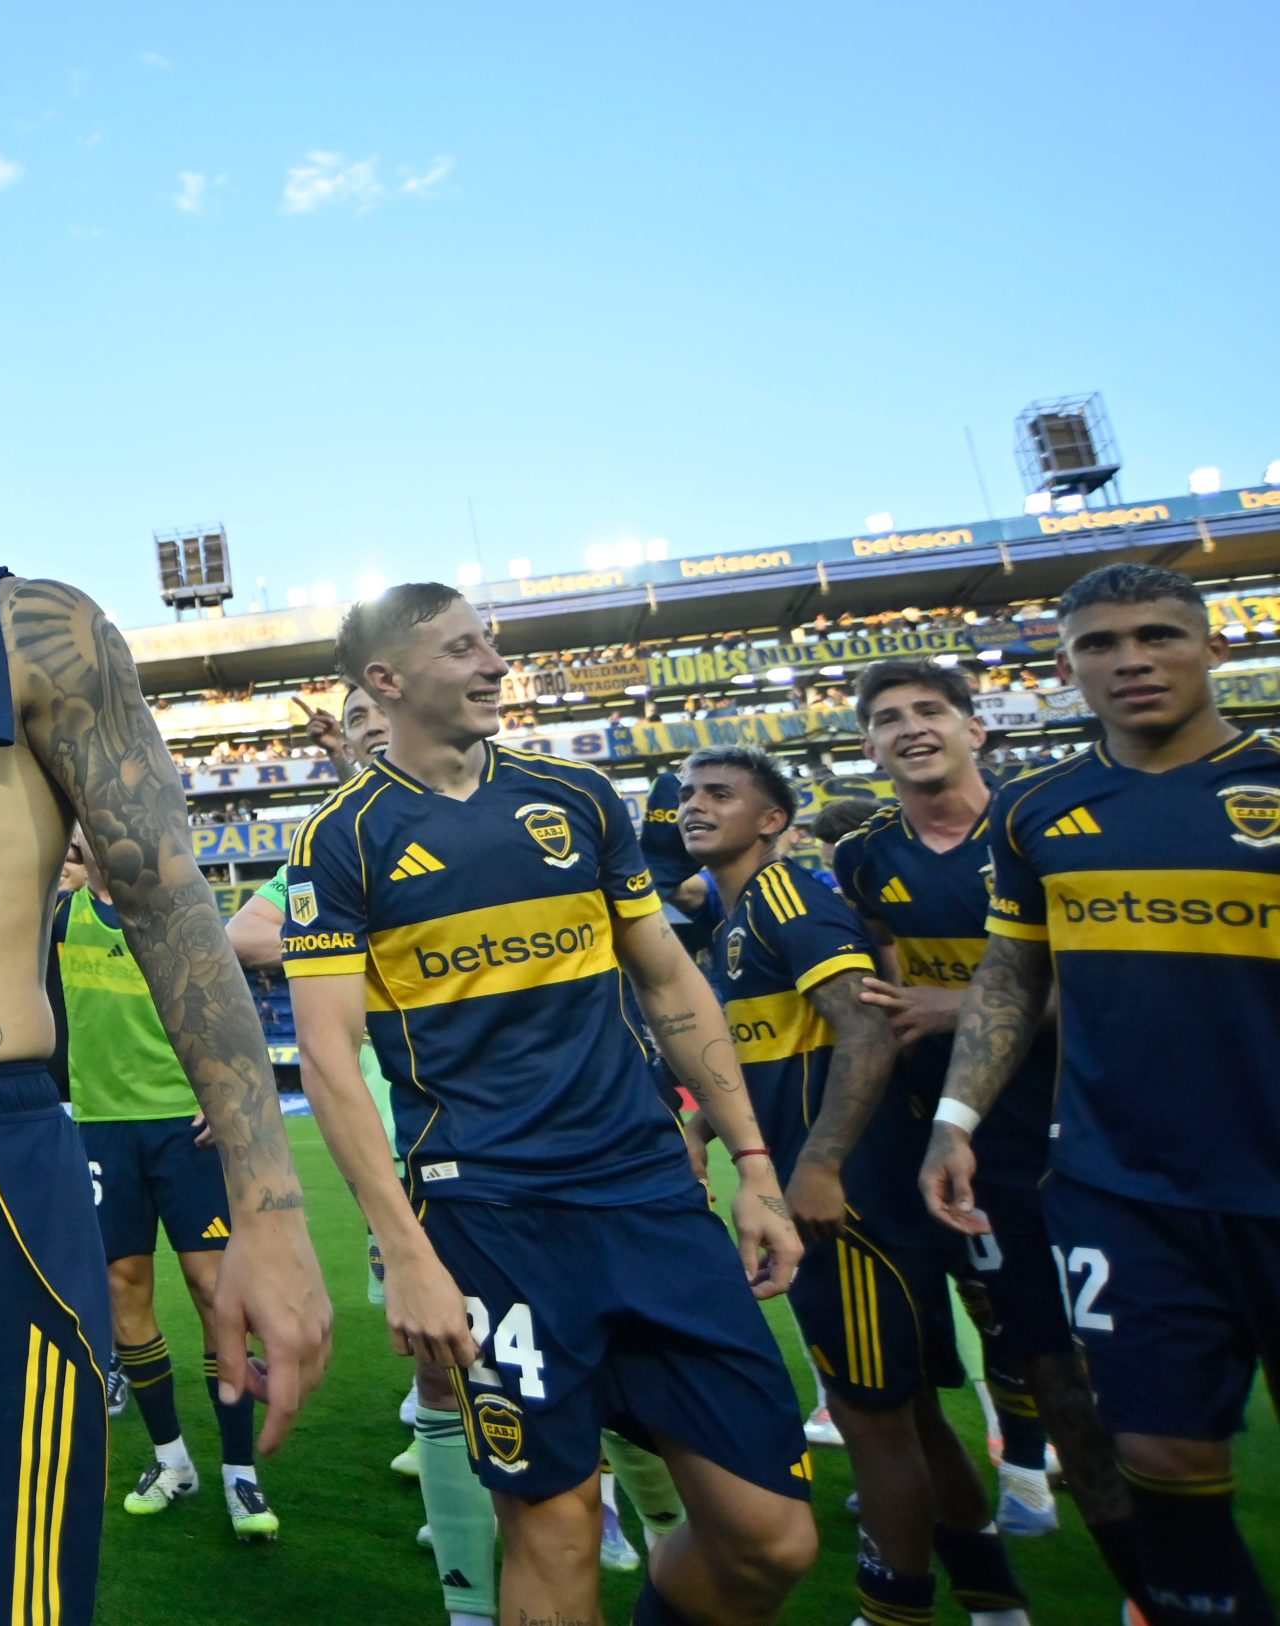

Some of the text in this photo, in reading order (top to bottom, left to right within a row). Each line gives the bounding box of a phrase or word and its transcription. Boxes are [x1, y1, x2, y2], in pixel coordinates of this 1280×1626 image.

[1038, 504, 1169, 535] betsson
[852, 528, 973, 557] betsson
[680, 550, 792, 577] betsson
[570, 664, 640, 680] VIEDMA
[649, 647, 750, 687] FLORES
[1235, 806, 1277, 818] CABJ
[535, 826, 564, 838] CABJ
[414, 921, 595, 980] betsson
[463, 1296, 546, 1399] 24
[485, 1424, 516, 1438] CABJ
